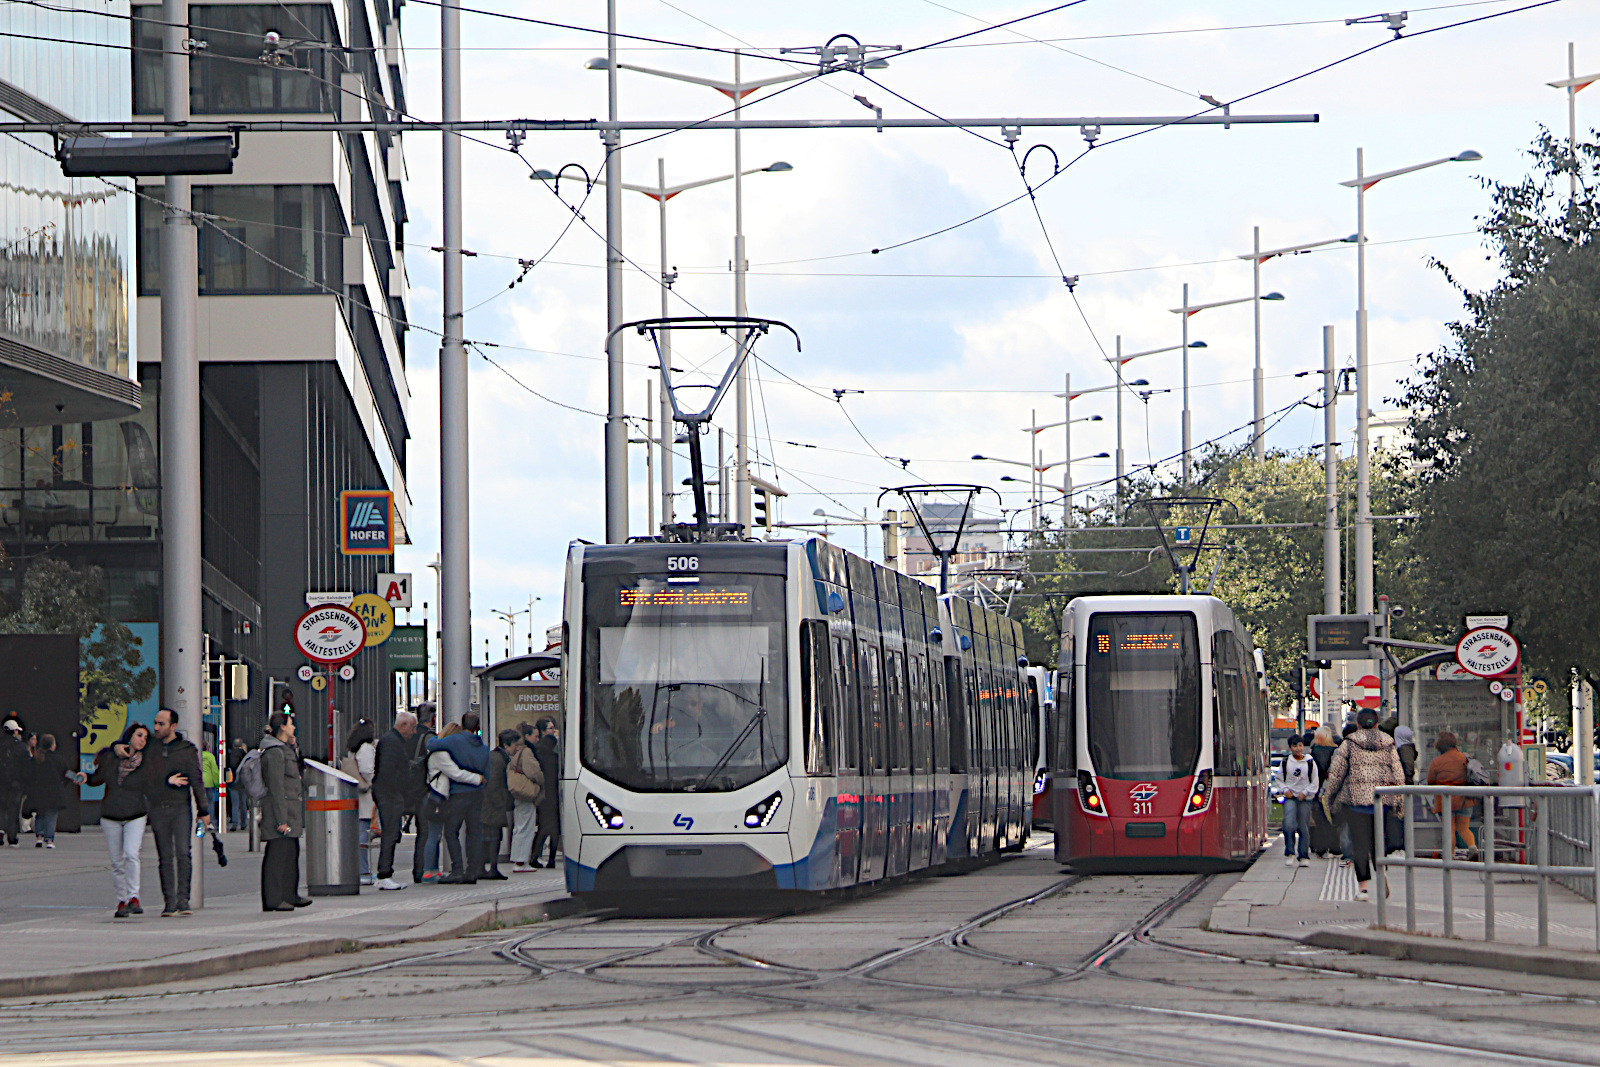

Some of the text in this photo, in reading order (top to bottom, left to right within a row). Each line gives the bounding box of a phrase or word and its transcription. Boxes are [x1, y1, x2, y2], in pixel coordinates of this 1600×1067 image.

[350, 530, 385, 540] HOFER
[1178, 528, 1188, 539] T
[667, 556, 699, 571] 506
[386, 578, 407, 601] A1
[355, 603, 376, 616] FAT
[302, 611, 359, 631] STRASSENBAHN
[362, 612, 387, 628] ONK
[304, 640, 356, 656] HALTESTELLE
[1462, 632, 1512, 651] STRASSENBAHN
[1465, 655, 1511, 672] HALTESTELLE
[300, 669, 311, 678] 18
[316, 678, 321, 687] 1
[518, 694, 545, 702] FINDE
[1527, 690, 1532, 698] 1
[1133, 802, 1152, 814] 311
